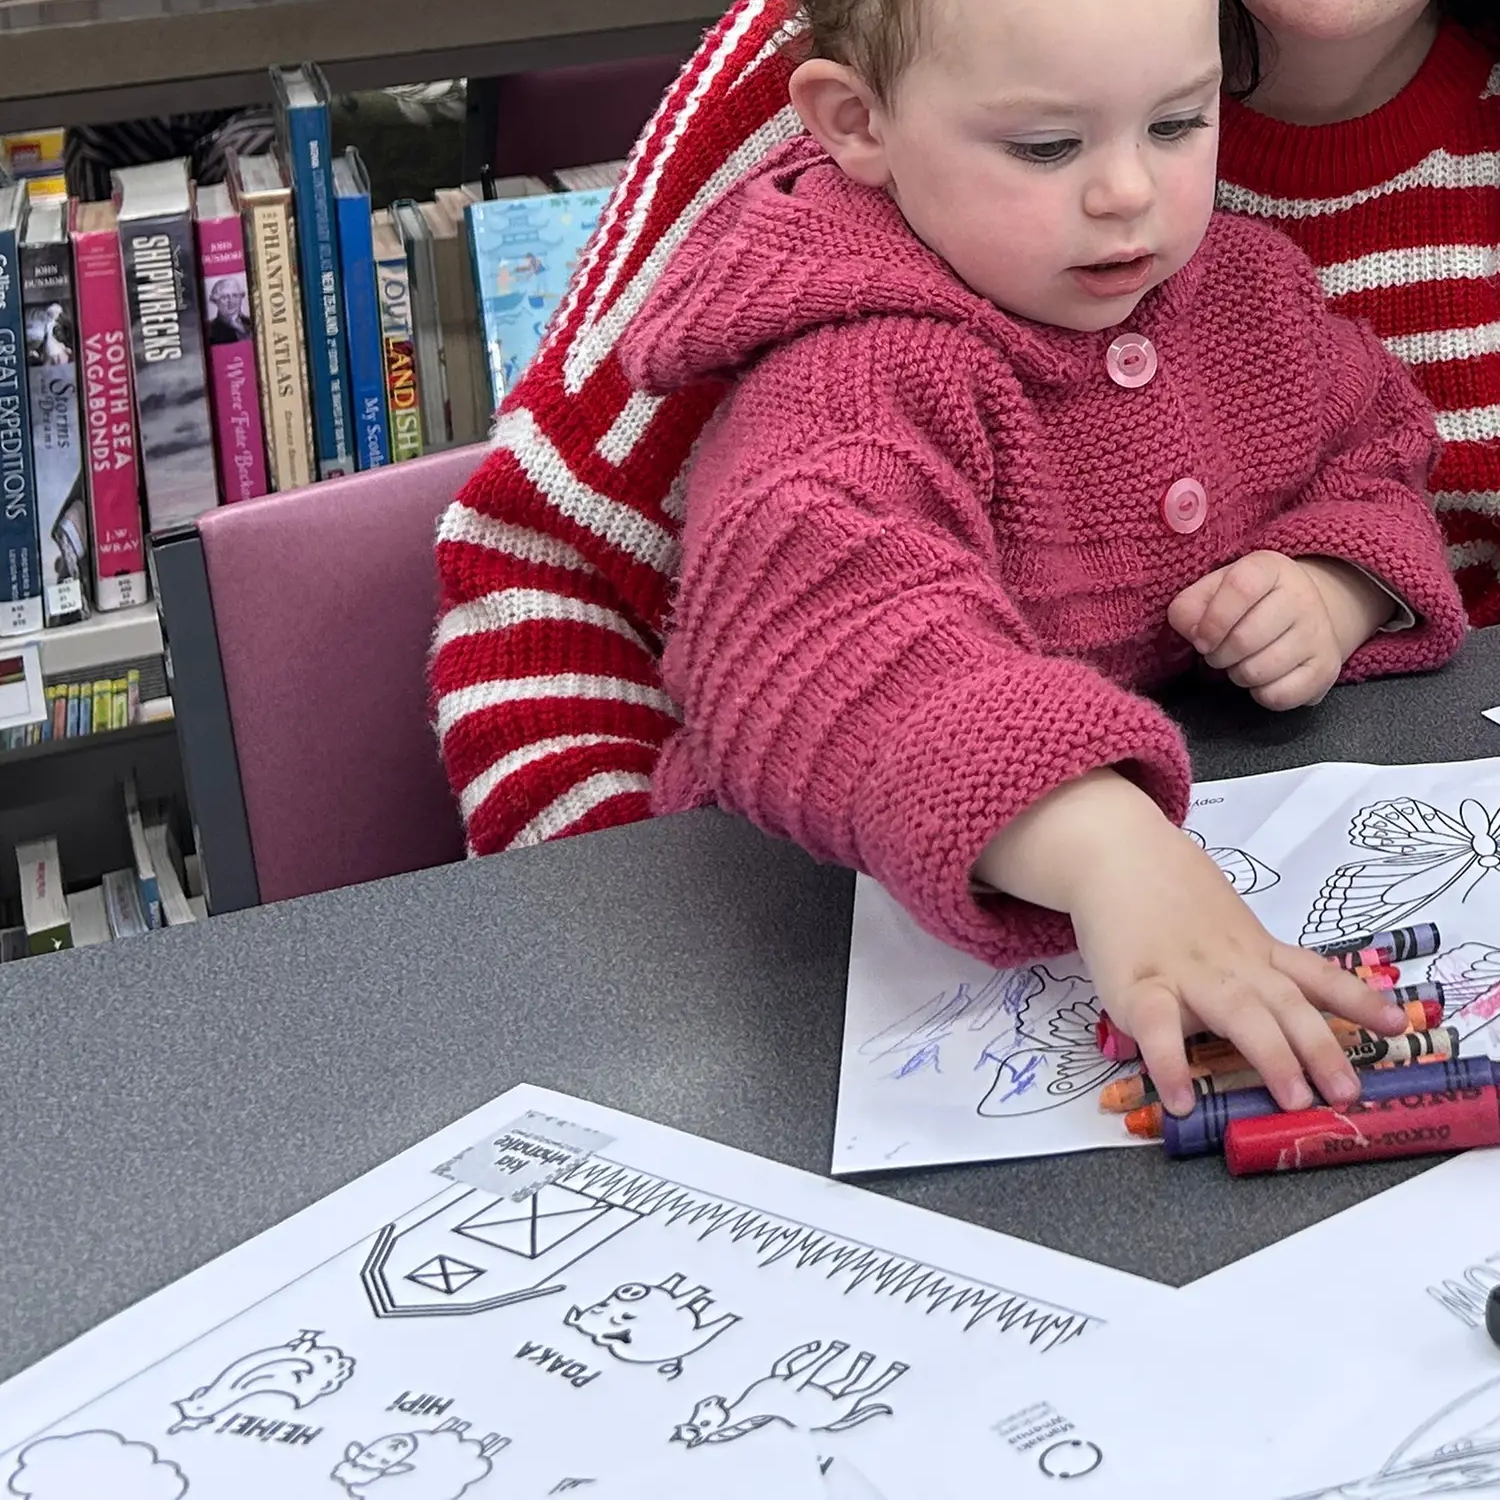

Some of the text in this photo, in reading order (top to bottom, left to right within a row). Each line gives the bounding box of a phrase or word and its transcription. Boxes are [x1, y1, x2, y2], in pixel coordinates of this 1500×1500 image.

[34, 263, 58, 277] JOHN
[131, 233, 183, 364] SHIPWRECKS
[260, 219, 294, 398] PHANTOM ATLAS
[104, 330, 133, 472] SOUTH SEA
[382, 275, 418, 456] OUTLANDISH
[47, 376, 77, 449] Storms
[83, 332, 111, 473] VAGABONDS
[99, 537, 141, 556] WRAY
[494, 1134, 572, 1165] whanake
[494, 1154, 530, 1175] kia
[513, 1340, 603, 1388] POAKA
